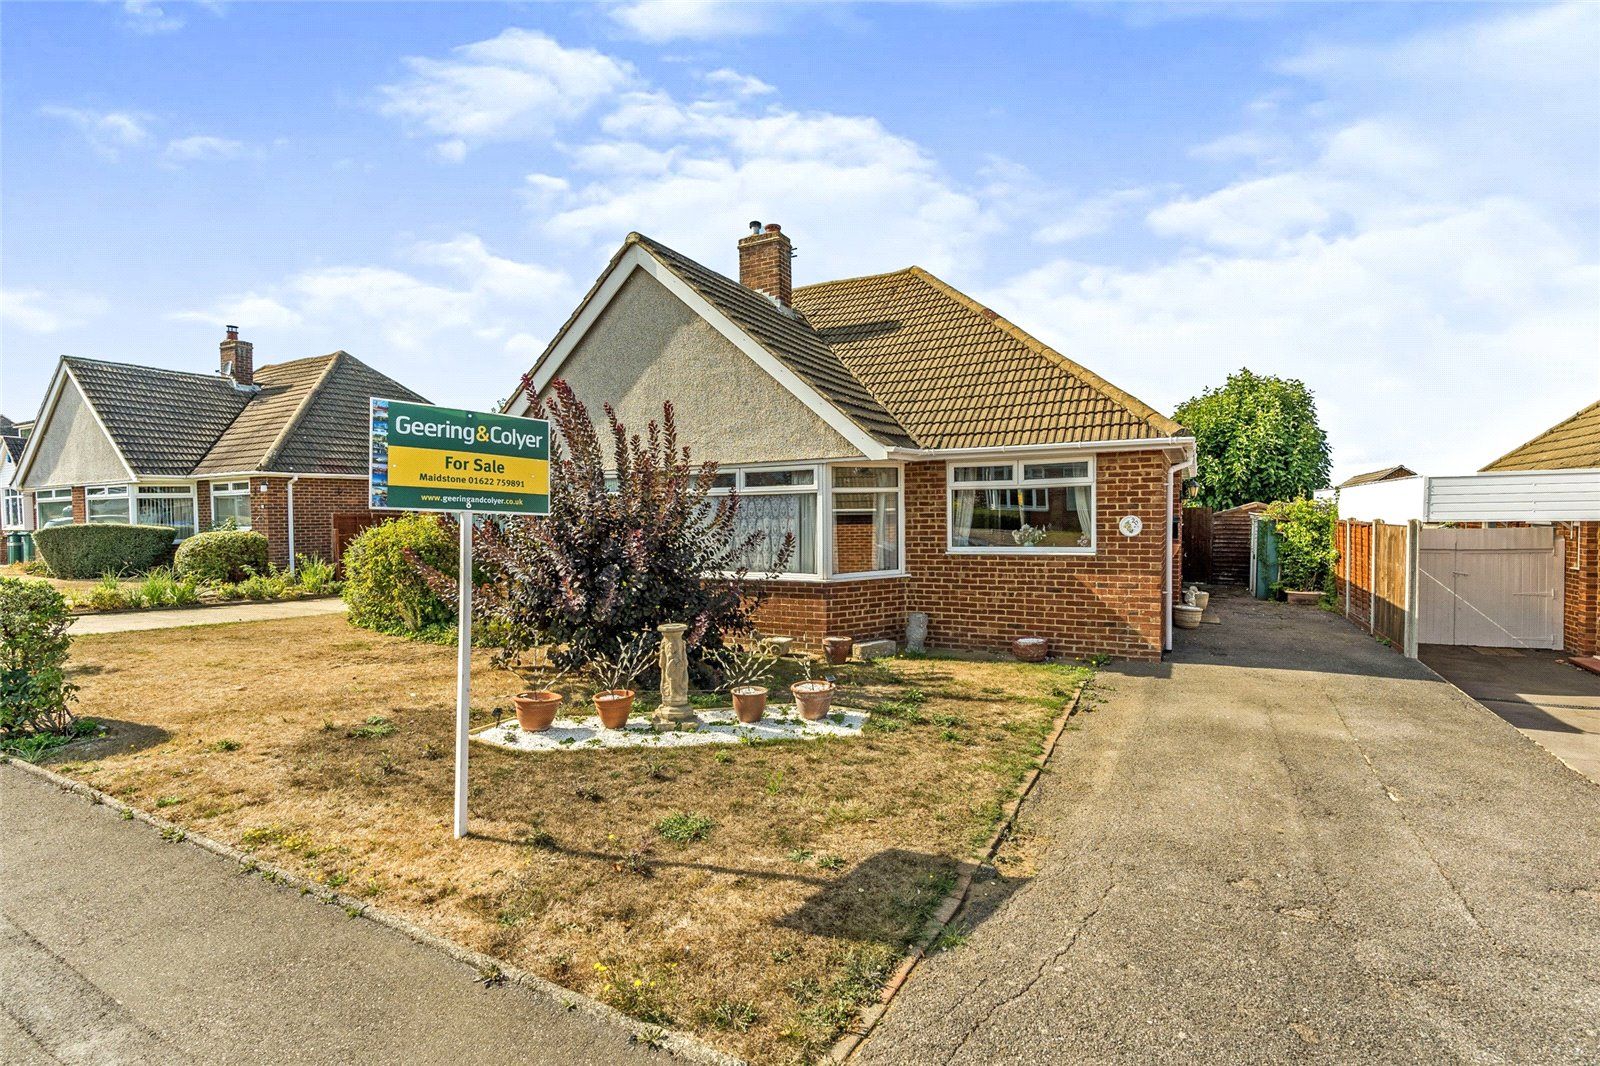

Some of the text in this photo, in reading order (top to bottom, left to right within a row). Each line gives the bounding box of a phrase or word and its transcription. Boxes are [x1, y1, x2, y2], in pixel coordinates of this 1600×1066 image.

[395, 416, 543, 450] Geering&Colyer
[445, 456, 504, 473] For Sale
[419, 473, 525, 488] Maidstone 01622 759891
[421, 494, 523, 506] www.geeringandcolyer.co.uk
